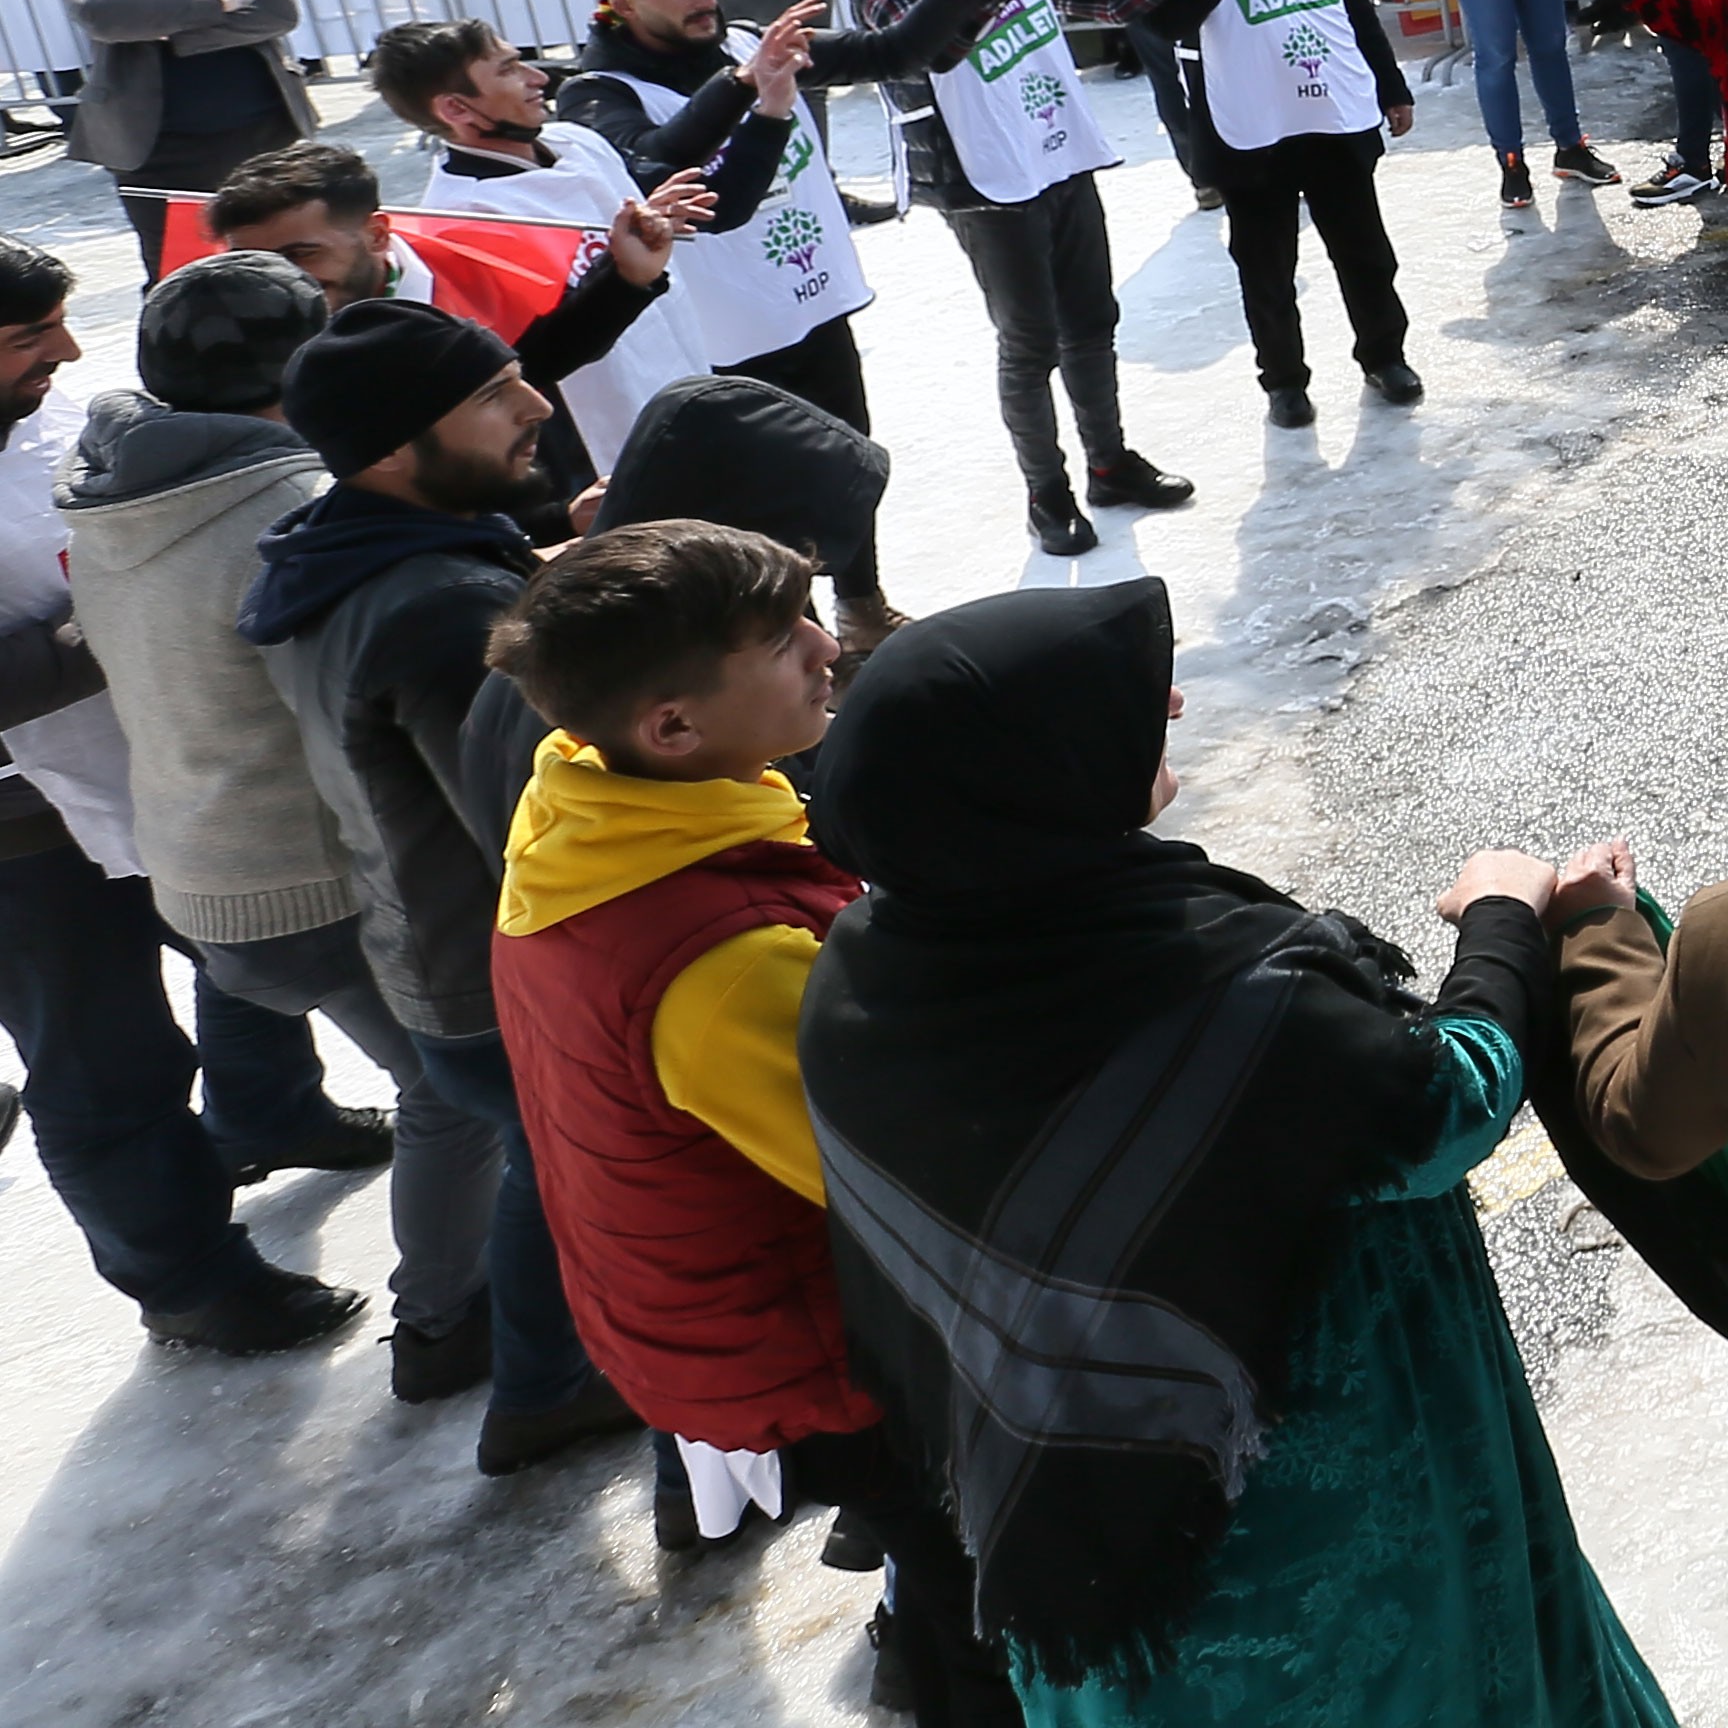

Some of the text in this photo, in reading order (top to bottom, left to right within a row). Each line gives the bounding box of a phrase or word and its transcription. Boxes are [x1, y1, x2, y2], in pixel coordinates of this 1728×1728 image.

[978, 6, 1056, 74] ADALET
[1042, 130, 1067, 154] HDP
[794, 271, 829, 304] HDP
